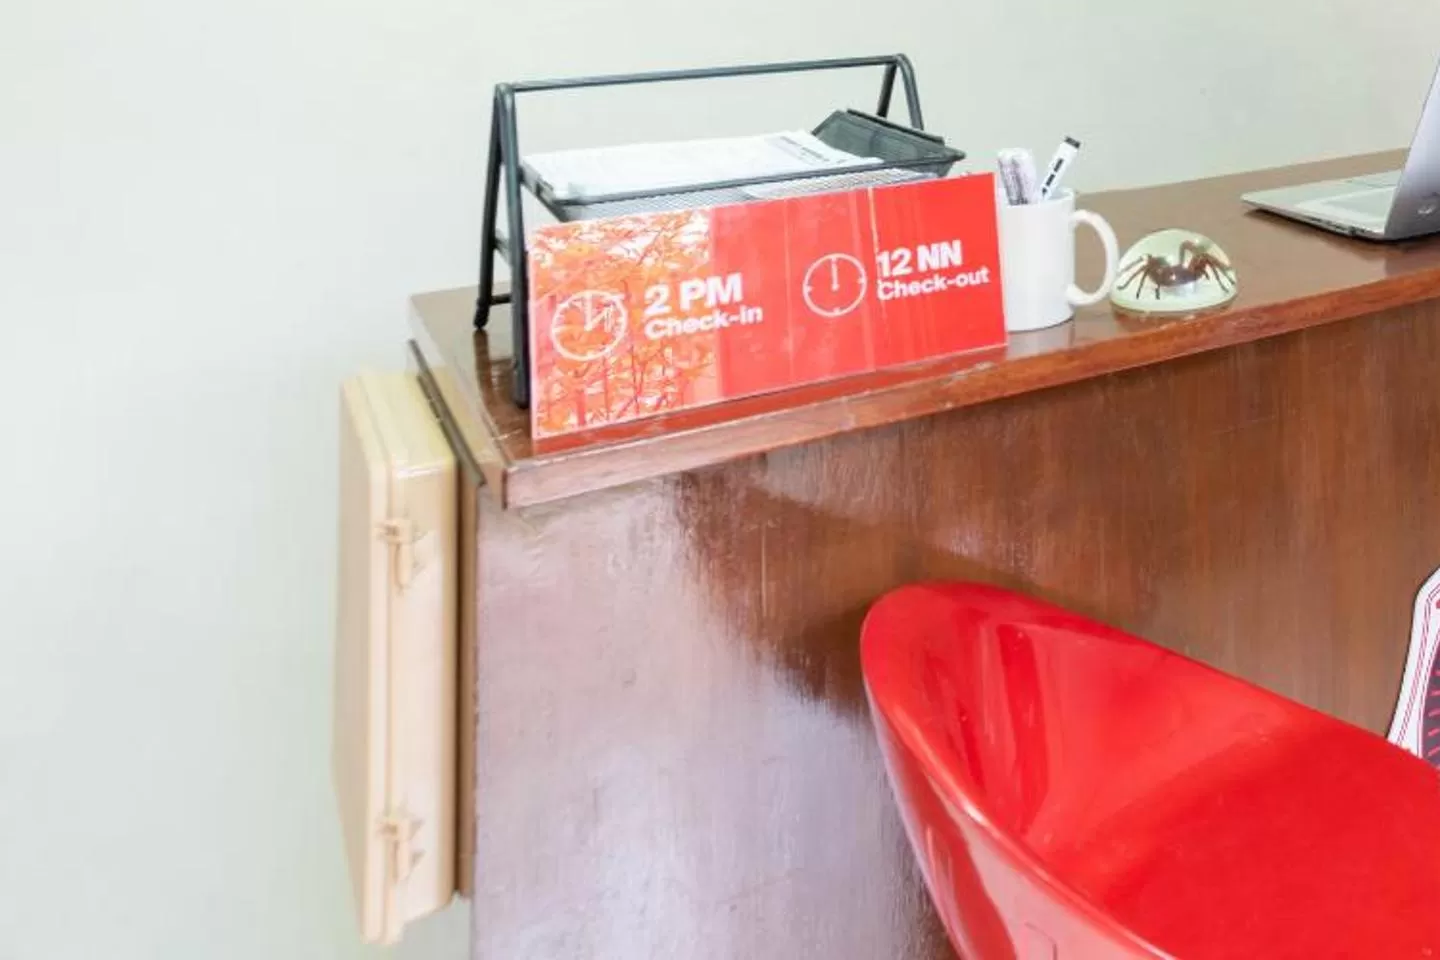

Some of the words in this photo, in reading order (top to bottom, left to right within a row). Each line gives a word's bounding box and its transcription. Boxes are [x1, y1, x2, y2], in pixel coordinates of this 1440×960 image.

[877, 247, 913, 278] 12
[917, 238, 963, 273] NN
[643, 283, 672, 316] 2
[680, 271, 743, 312] PM
[877, 265, 990, 301] Check-out
[644, 304, 763, 340] Check-in
